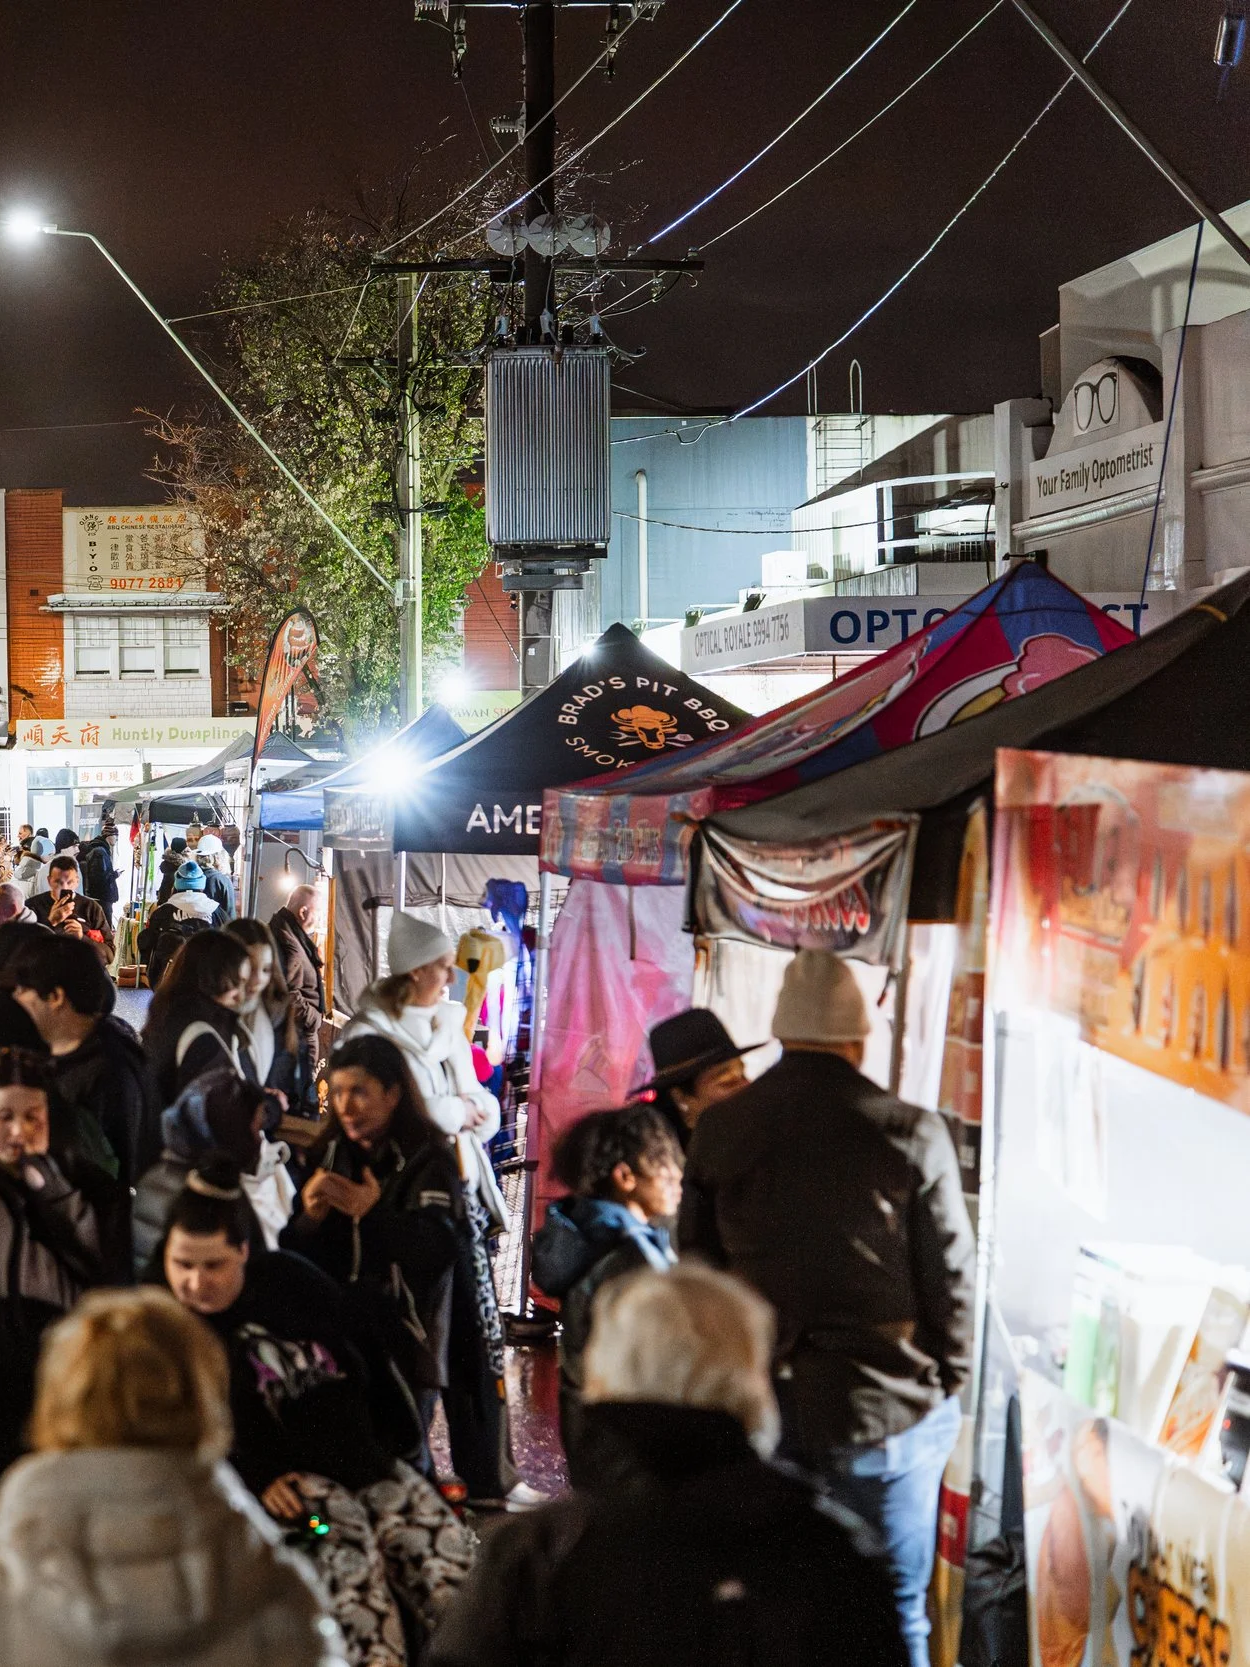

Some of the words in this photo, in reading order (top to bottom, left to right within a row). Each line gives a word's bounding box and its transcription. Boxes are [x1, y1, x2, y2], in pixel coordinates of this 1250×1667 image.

[1037, 475, 1059, 498] Your
[1060, 469, 1090, 493] Family
[1091, 442, 1154, 488] Optometrist
[110, 578, 144, 589] 9077
[694, 628, 723, 657] OPTICAL
[724, 623, 752, 652] ROYALE
[753, 618, 770, 646] 9994
[771, 613, 790, 643] 7756
[558, 676, 627, 725] BRAD'S
[636, 676, 679, 697] PIT
[683, 698, 730, 732] BBQ
[23, 722, 100, 746] 順天府
[112, 727, 163, 743] Huntly
[466, 803, 542, 835] AME
